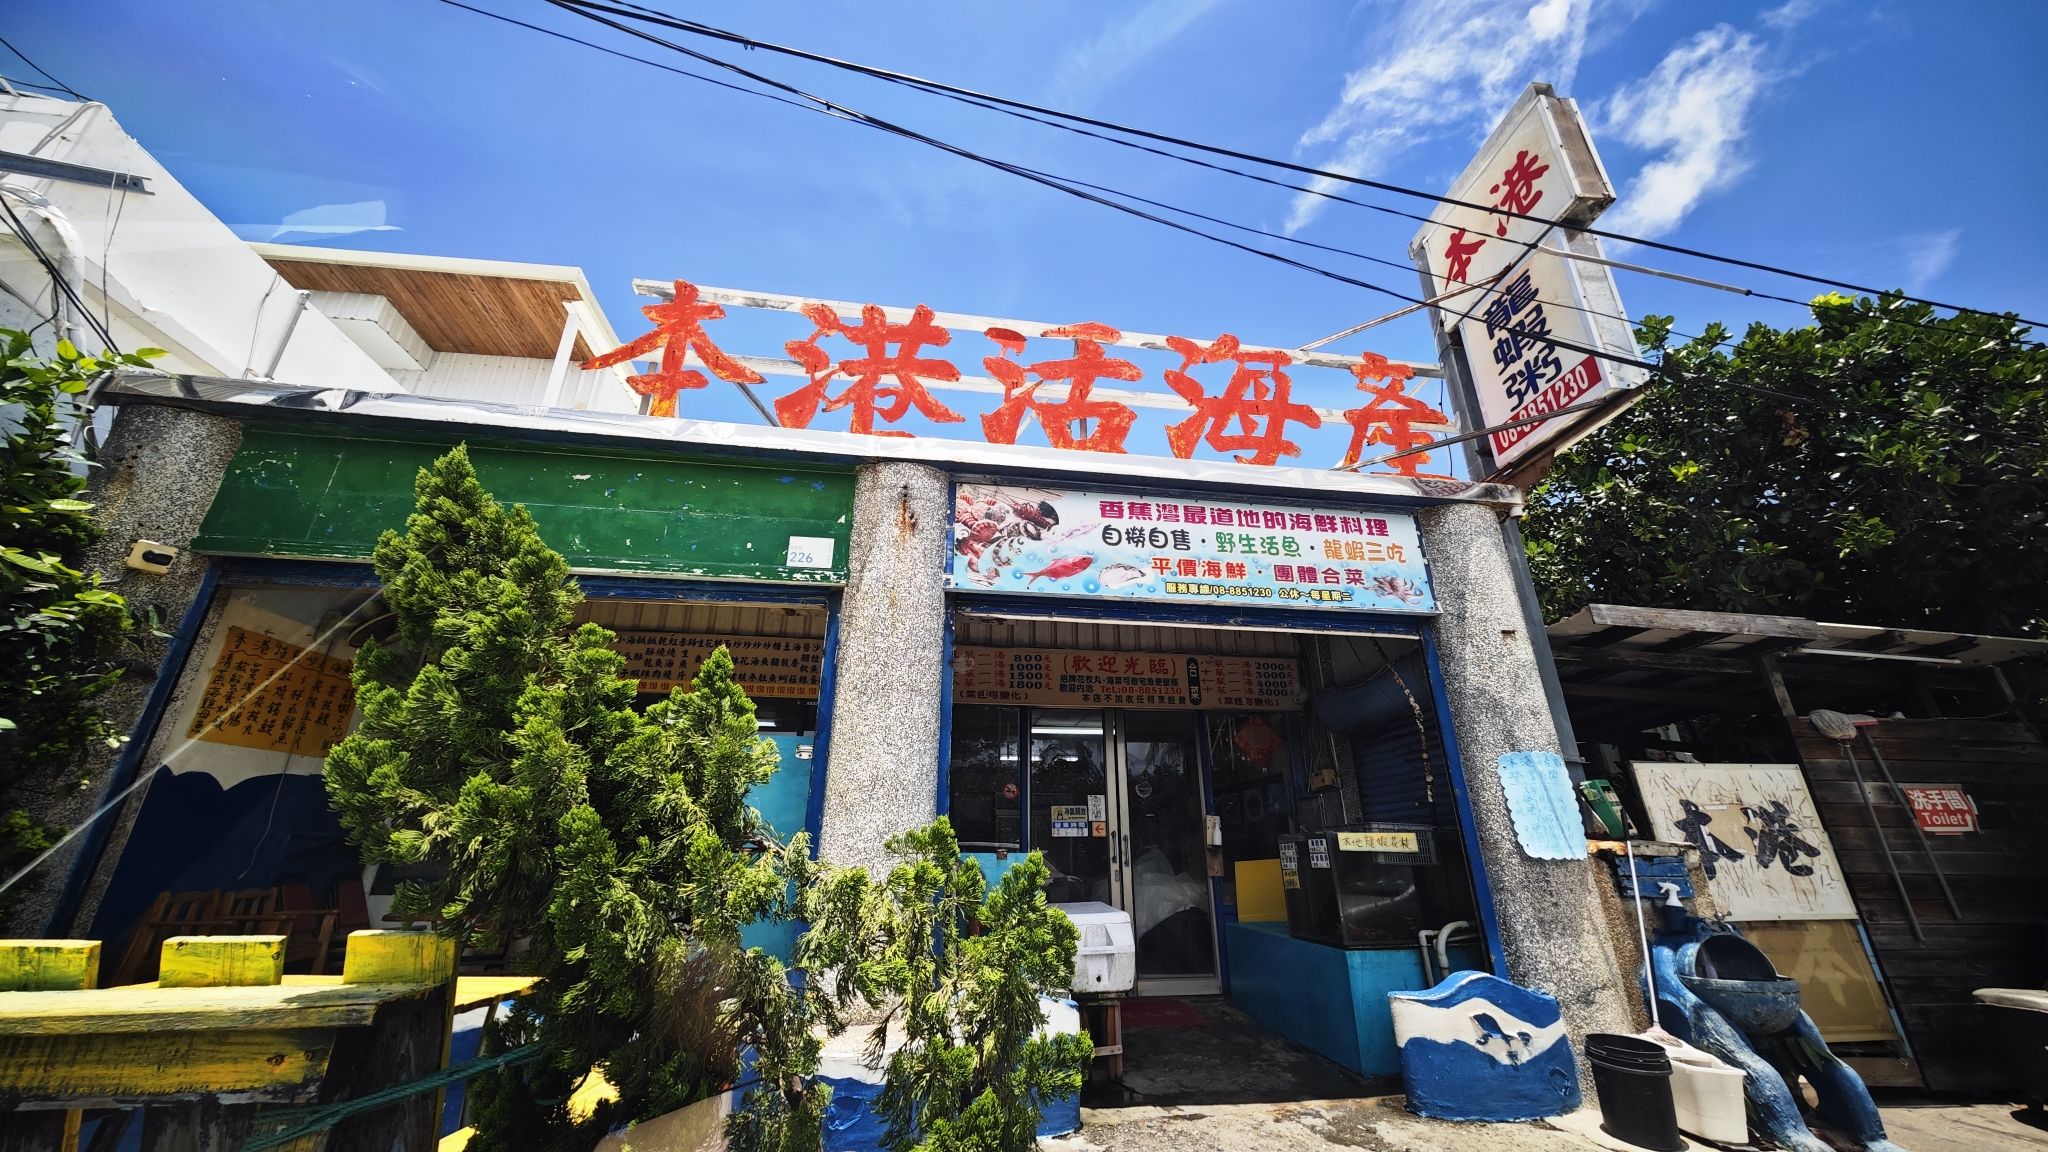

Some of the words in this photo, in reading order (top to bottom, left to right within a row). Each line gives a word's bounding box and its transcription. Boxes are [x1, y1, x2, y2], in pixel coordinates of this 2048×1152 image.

[1445, 150, 1549, 291] 本港
[1483, 269, 1562, 412] 龍蝦粥
[582, 280, 1455, 480] 本港活海產
[1099, 500, 1389, 537] 香蕉灣最道地的海鮮料理
[790, 552, 813, 563] 226
[1102, 524, 1191, 552] 自撈自售
[1215, 531, 1302, 557] 野生活魚
[1323, 538, 1406, 564] 龍蝦三吃
[1151, 556, 1247, 581] 平價海鮮
[1273, 564, 1366, 586] 團體合菜
[1908, 789, 1968, 810] 洗手間
[1921, 812, 1965, 825] Toilet
[1674, 799, 1820, 880] 本港
